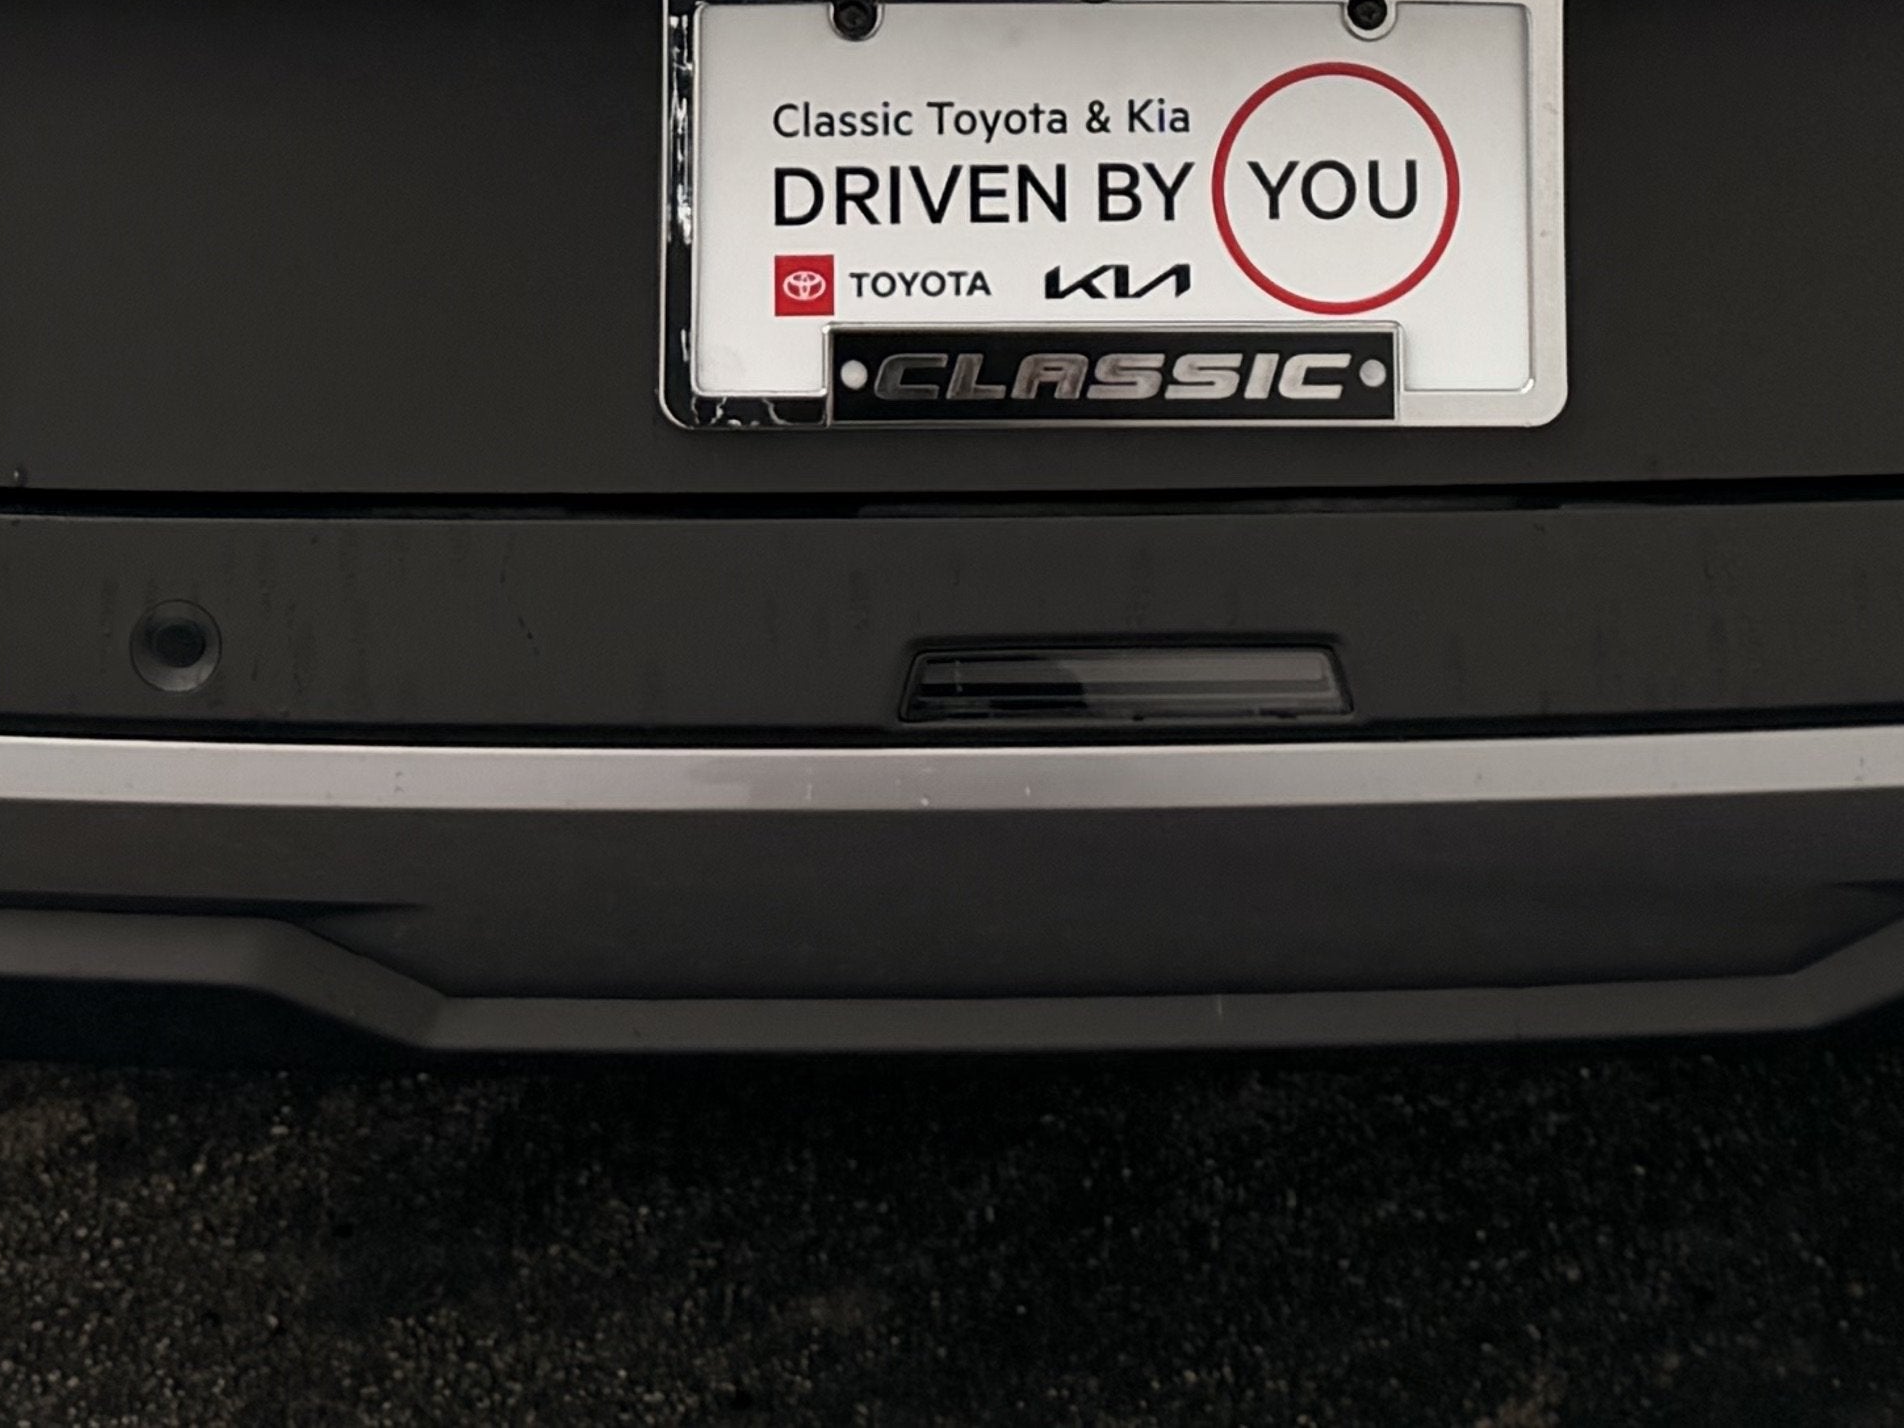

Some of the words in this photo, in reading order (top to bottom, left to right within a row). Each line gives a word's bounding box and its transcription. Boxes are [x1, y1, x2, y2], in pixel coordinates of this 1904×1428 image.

[772, 101, 914, 139] Classic
[926, 100, 1069, 144] Toyota
[1084, 98, 1112, 134] &
[1126, 97, 1191, 134] Kia
[773, 163, 1069, 227] DRIVEN
[1097, 161, 1195, 222] BY
[1247, 158, 1419, 221] YOU
[848, 270, 992, 299] TOYOTA
[1044, 263, 1192, 301] KIA
[872, 351, 1351, 401] CLASSIC
